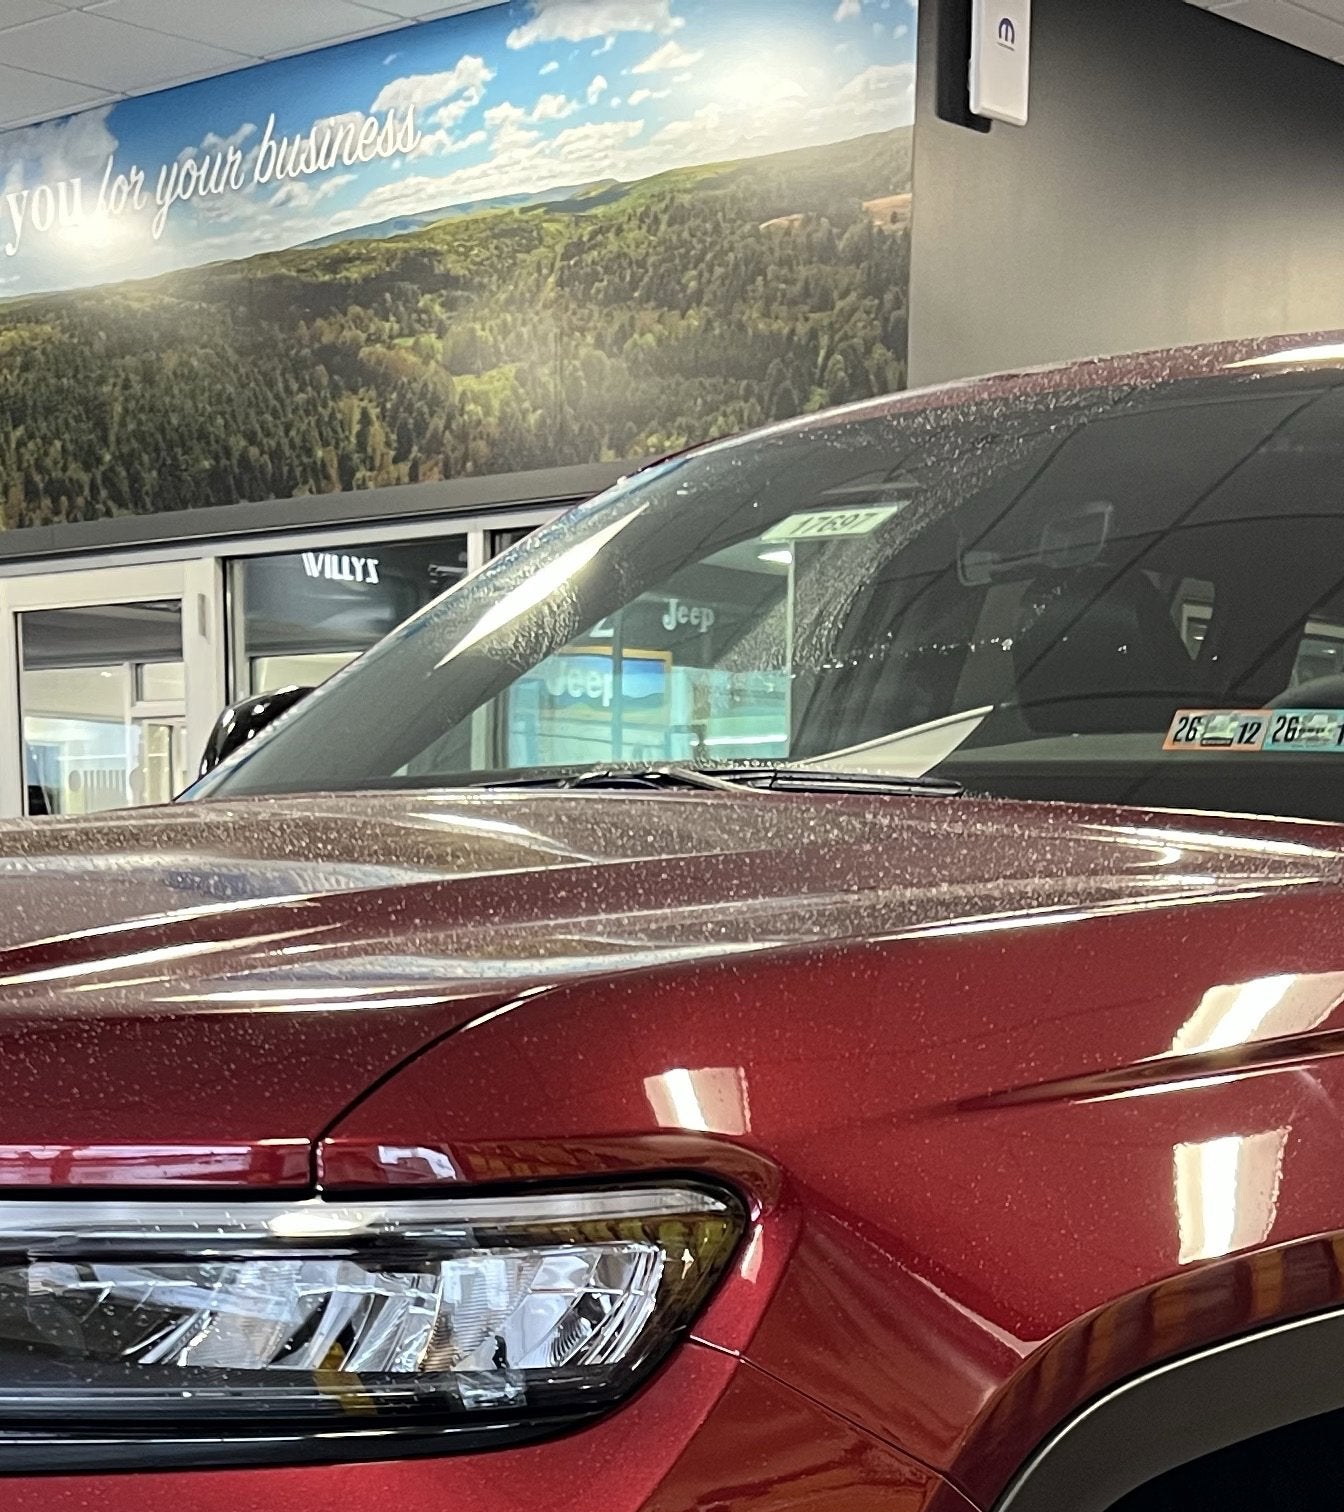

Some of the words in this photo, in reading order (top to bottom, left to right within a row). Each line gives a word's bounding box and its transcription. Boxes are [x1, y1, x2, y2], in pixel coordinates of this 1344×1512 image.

[2, 177, 85, 257] you
[94, 154, 149, 217] for
[152, 146, 245, 240] your
[252, 104, 423, 184] business
[789, 512, 879, 535] 17697
[301, 551, 380, 585] WILLYS
[662, 597, 716, 633] Jeep
[1172, 716, 1202, 745] 26
[1236, 721, 1262, 745] 12
[1271, 715, 1300, 744] 26
